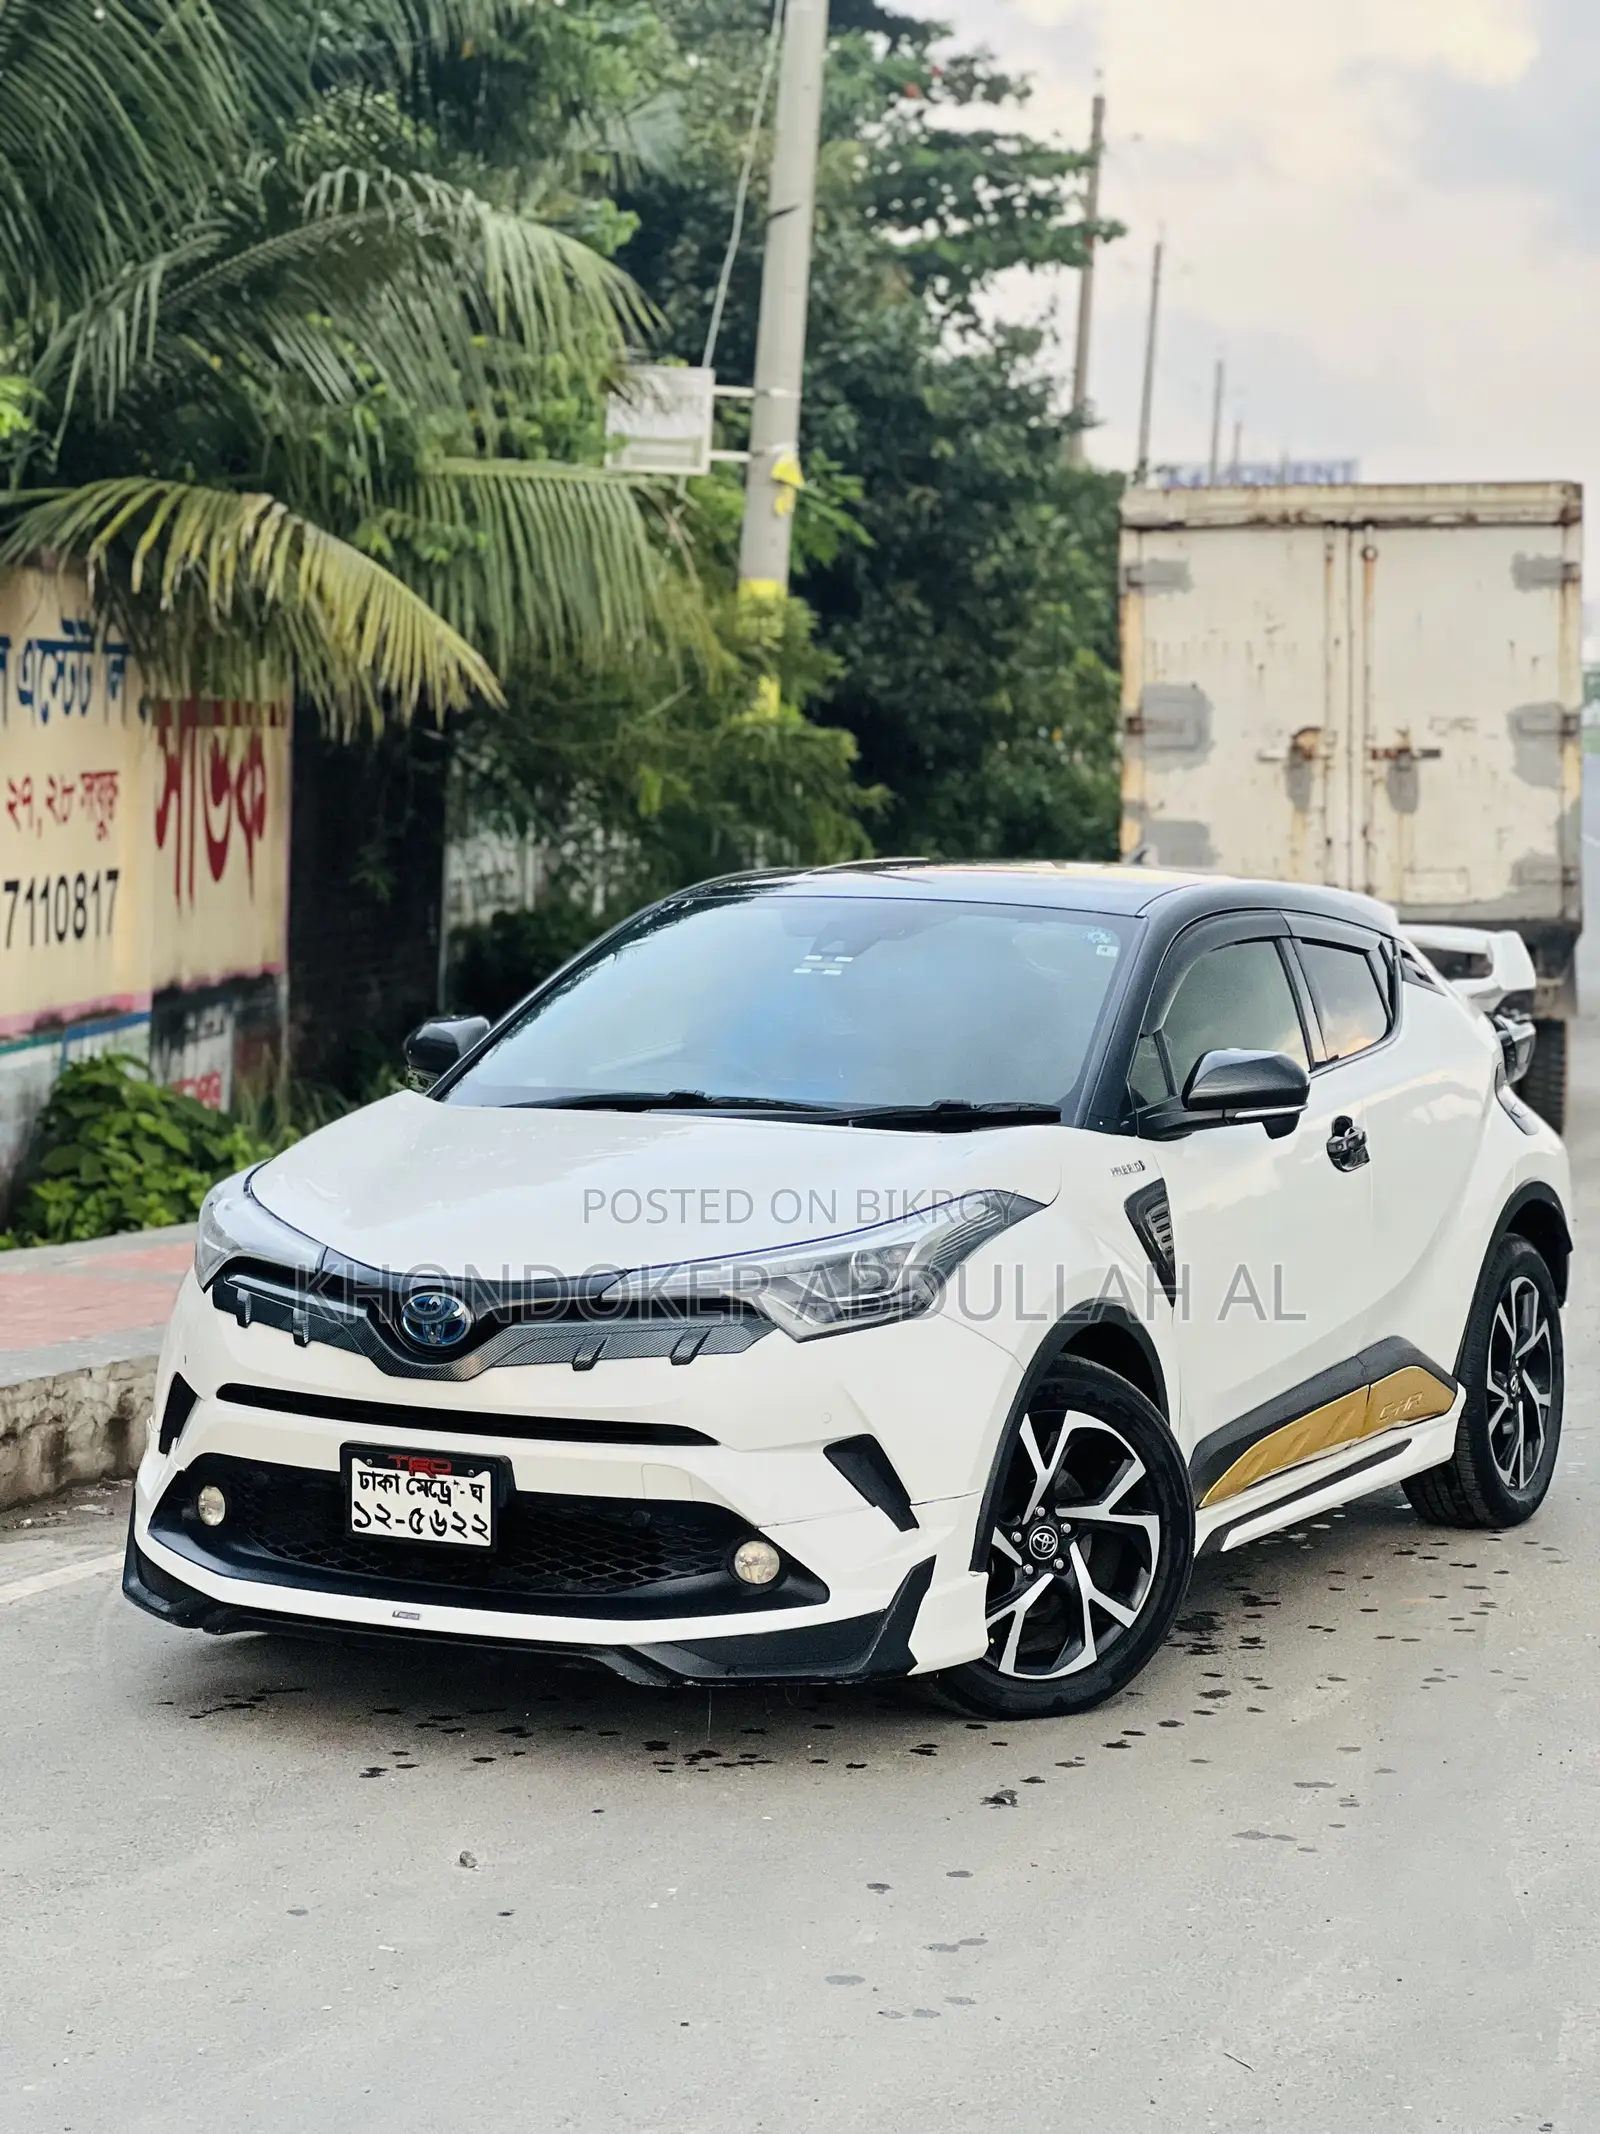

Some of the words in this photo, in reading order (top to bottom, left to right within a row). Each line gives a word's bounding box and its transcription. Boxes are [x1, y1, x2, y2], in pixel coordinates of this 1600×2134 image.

[3, 868, 119, 950] 7110817
[357, 1470, 401, 1494] ঢাকা
[388, 1455, 452, 1478] TRD
[353, 1500, 490, 1541] ১২-৫৬২২
